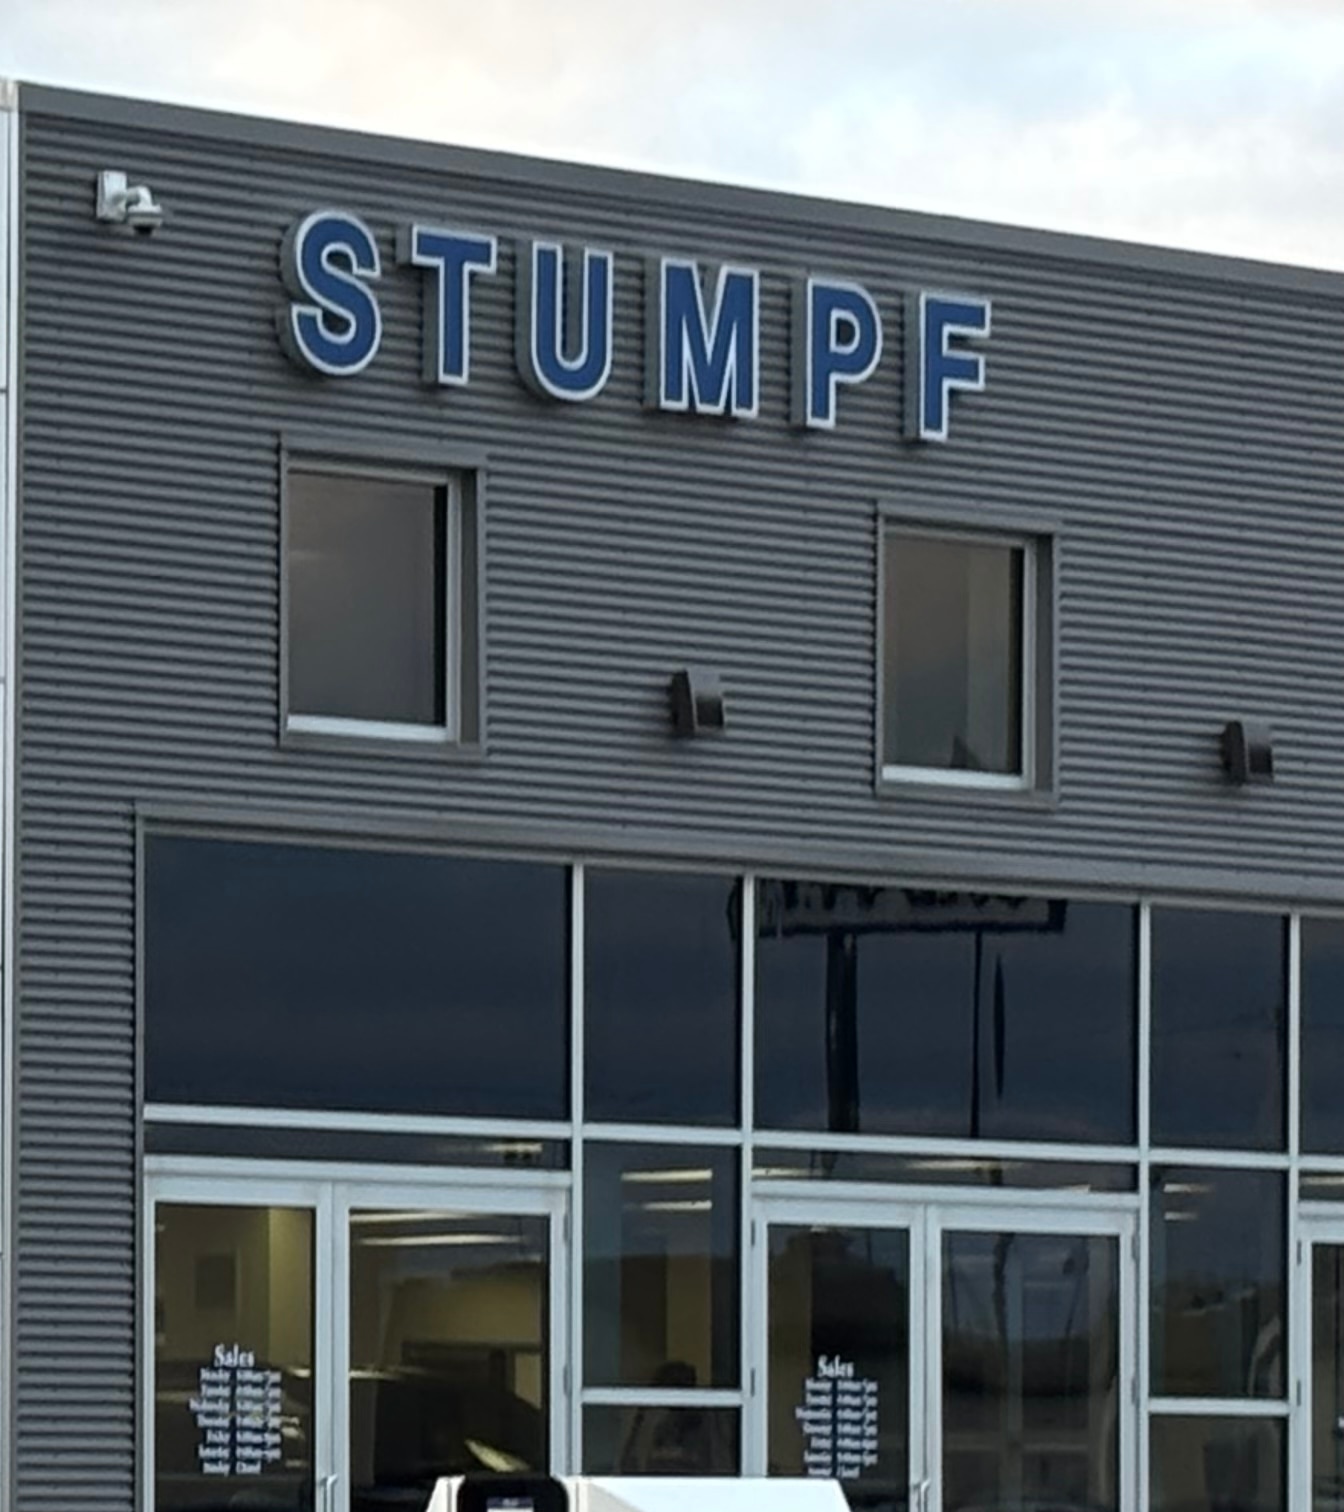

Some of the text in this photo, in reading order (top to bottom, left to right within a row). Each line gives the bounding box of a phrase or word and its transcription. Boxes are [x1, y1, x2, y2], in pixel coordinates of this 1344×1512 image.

[287, 210, 991, 443] STUMPF
[214, 1343, 255, 1368] Sales
[817, 1354, 854, 1378] Sales
